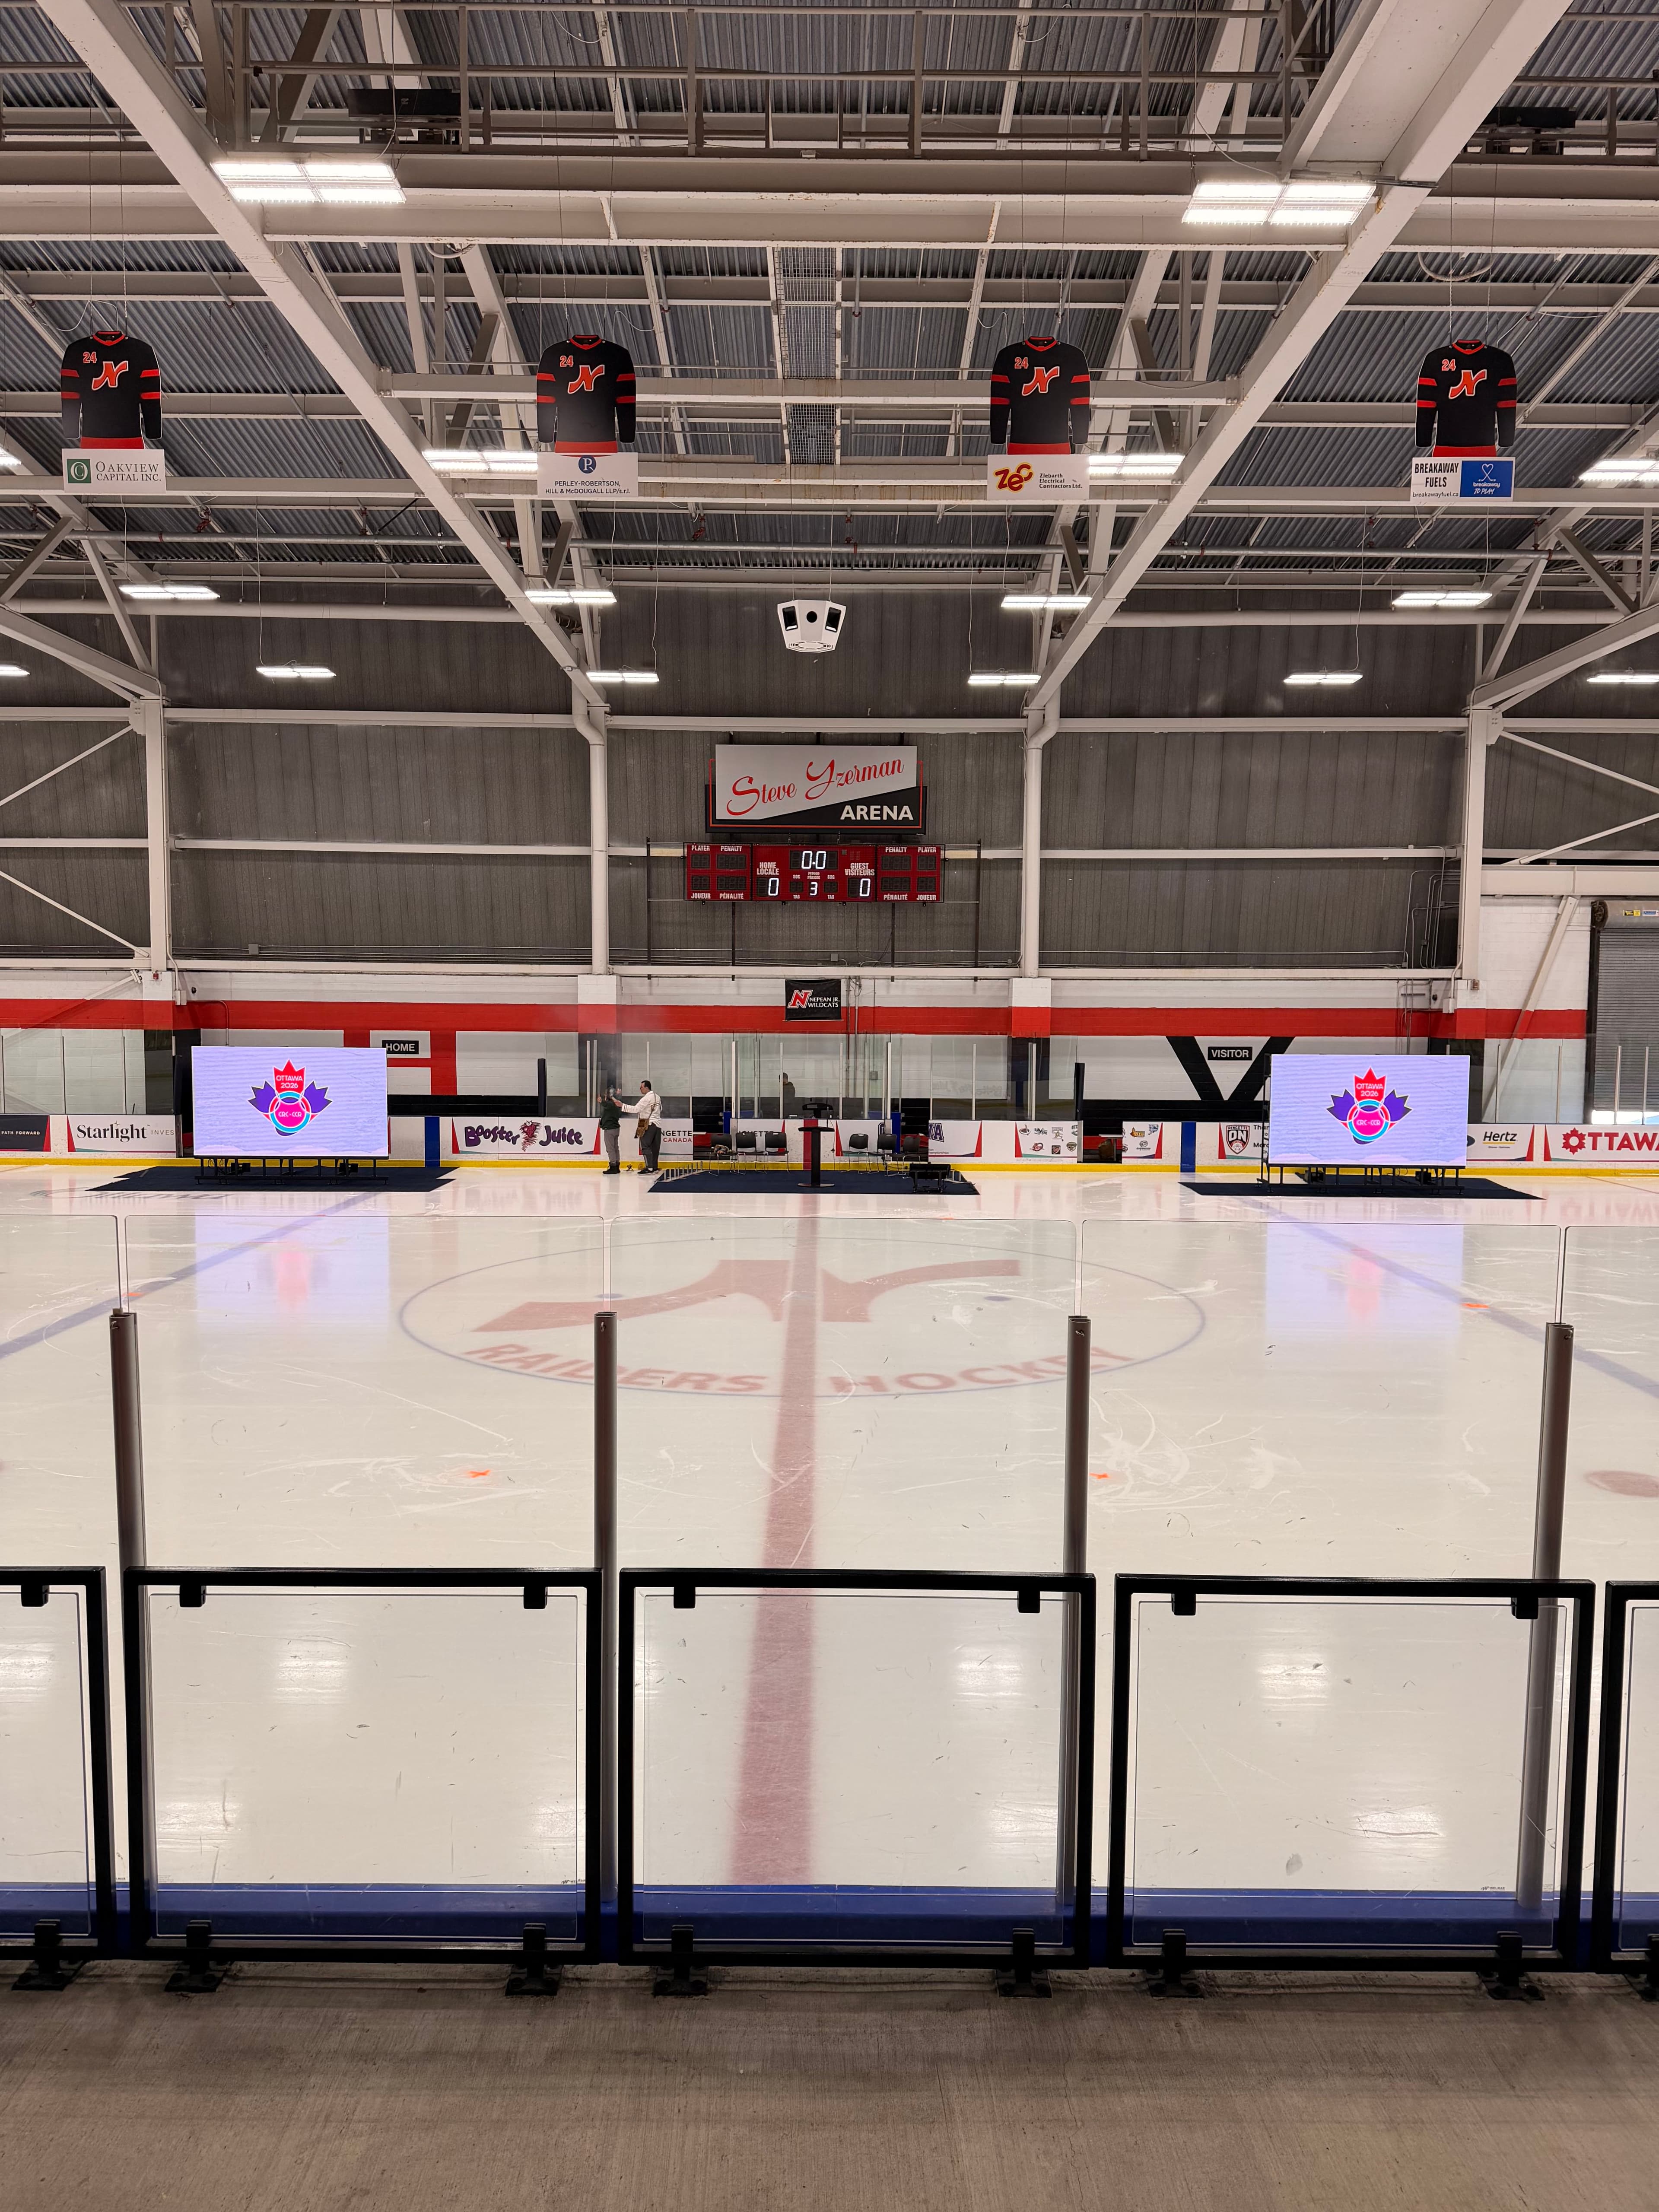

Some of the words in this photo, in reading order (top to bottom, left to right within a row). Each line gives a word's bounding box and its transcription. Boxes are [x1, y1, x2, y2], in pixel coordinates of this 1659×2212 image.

[83, 352, 97, 363] 24
[560, 356, 573, 367] 24
[1014, 357, 1029, 369] 24
[1442, 359, 1456, 371] 24
[96, 461, 159, 472] OAKVIEW
[1415, 463, 1459, 473] BREAKAWAY
[1425, 477, 1447, 487] FUELS
[726, 776, 797, 816] Steve
[805, 759, 905, 800] Yzerman
[840, 805, 913, 820] ARENA
[768, 878, 779, 896] 0
[810, 882, 818, 895] 3
[859, 878, 871, 896] 0
[386, 1043, 415, 1052] HOME
[1211, 1049, 1249, 1058] VISITOR
[77, 1123, 147, 1143] Starlight
[464, 1125, 520, 1147] Booster
[539, 1125, 583, 1146] Juice
[1229, 1130, 1247, 1142] ON
[1483, 1131, 1518, 1141] Hertz
[462, 1344, 767, 1392] RAIDERS
